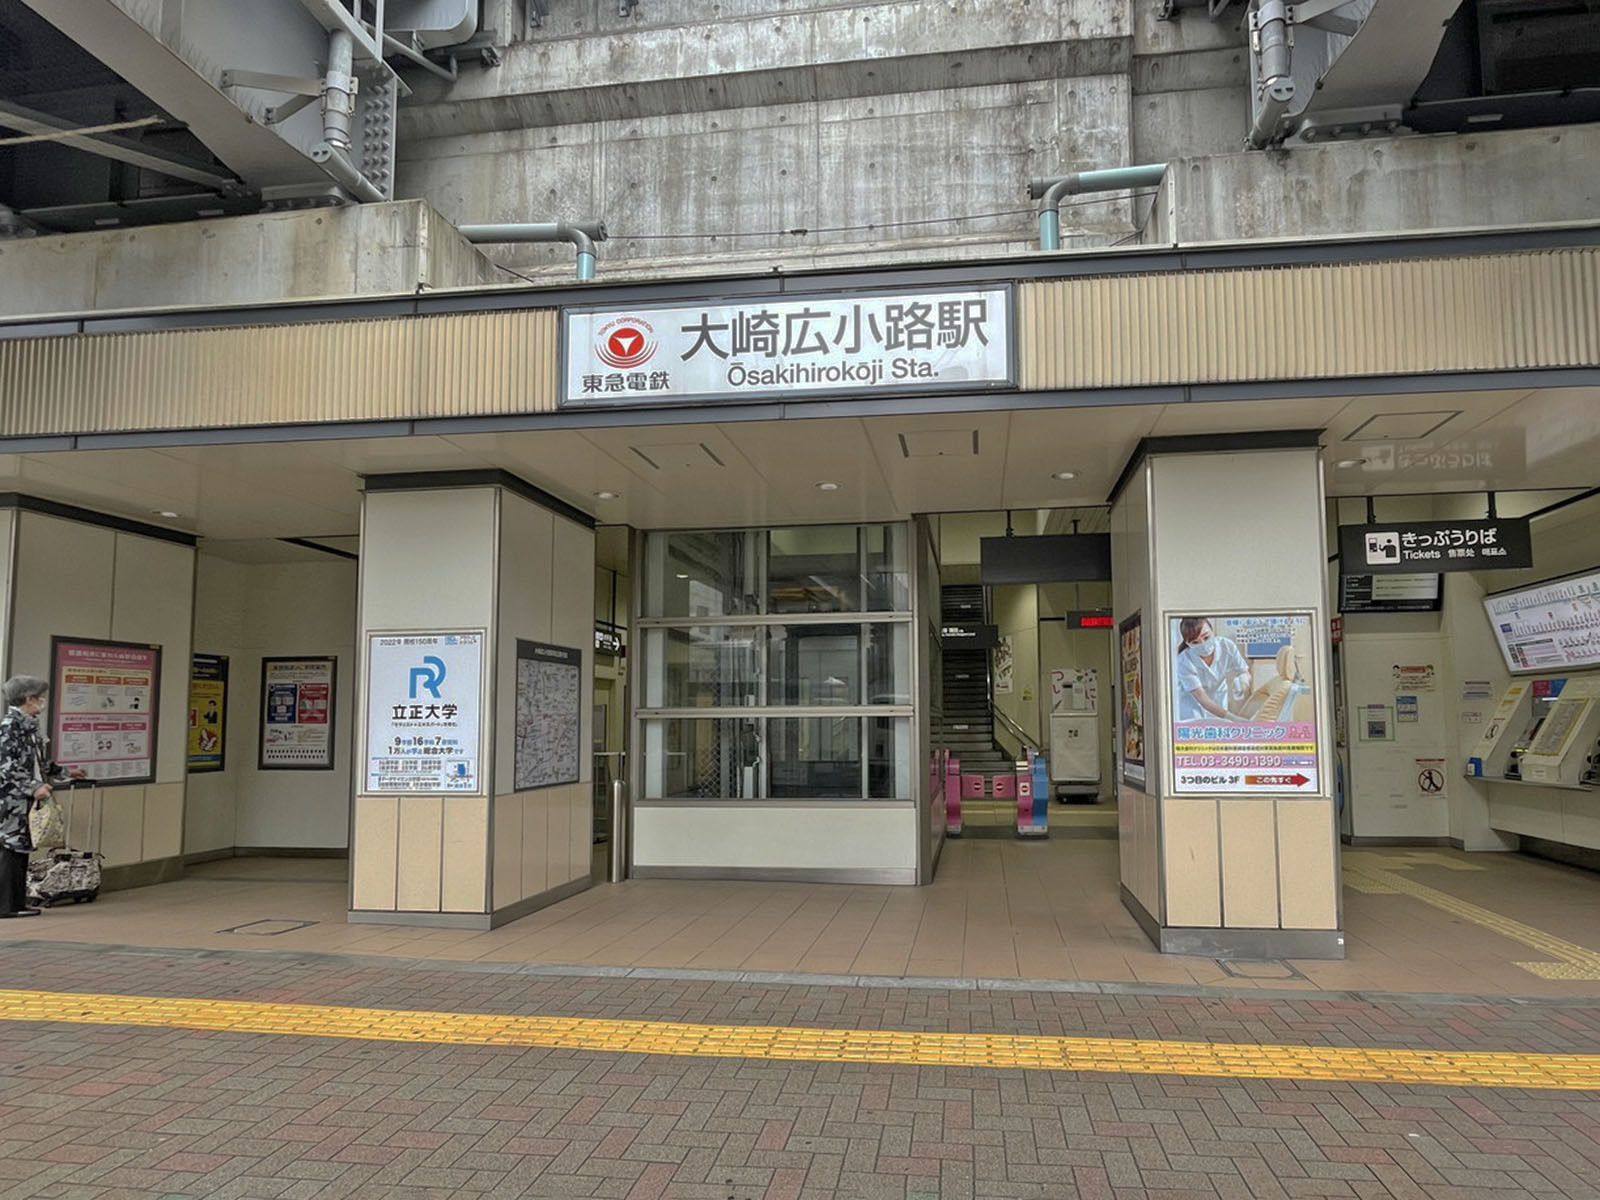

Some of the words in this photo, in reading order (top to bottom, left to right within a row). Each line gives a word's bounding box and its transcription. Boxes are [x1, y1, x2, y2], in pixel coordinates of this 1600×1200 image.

[680, 300, 989, 362] 大崎広小路駅
[727, 362, 883, 387] Ōsakihirokōji
[891, 357, 939, 379] Sta.
[582, 371, 670, 393] 東急電鉄
[1402, 527, 1498, 547] きっぷうりば
[1403, 549, 1441, 559] Tickets
[392, 704, 458, 720] 立正大学
[1177, 726, 1286, 740] 陽光歯科クリニック
[1176, 756, 1281, 768] TEL.03-3490-1390
